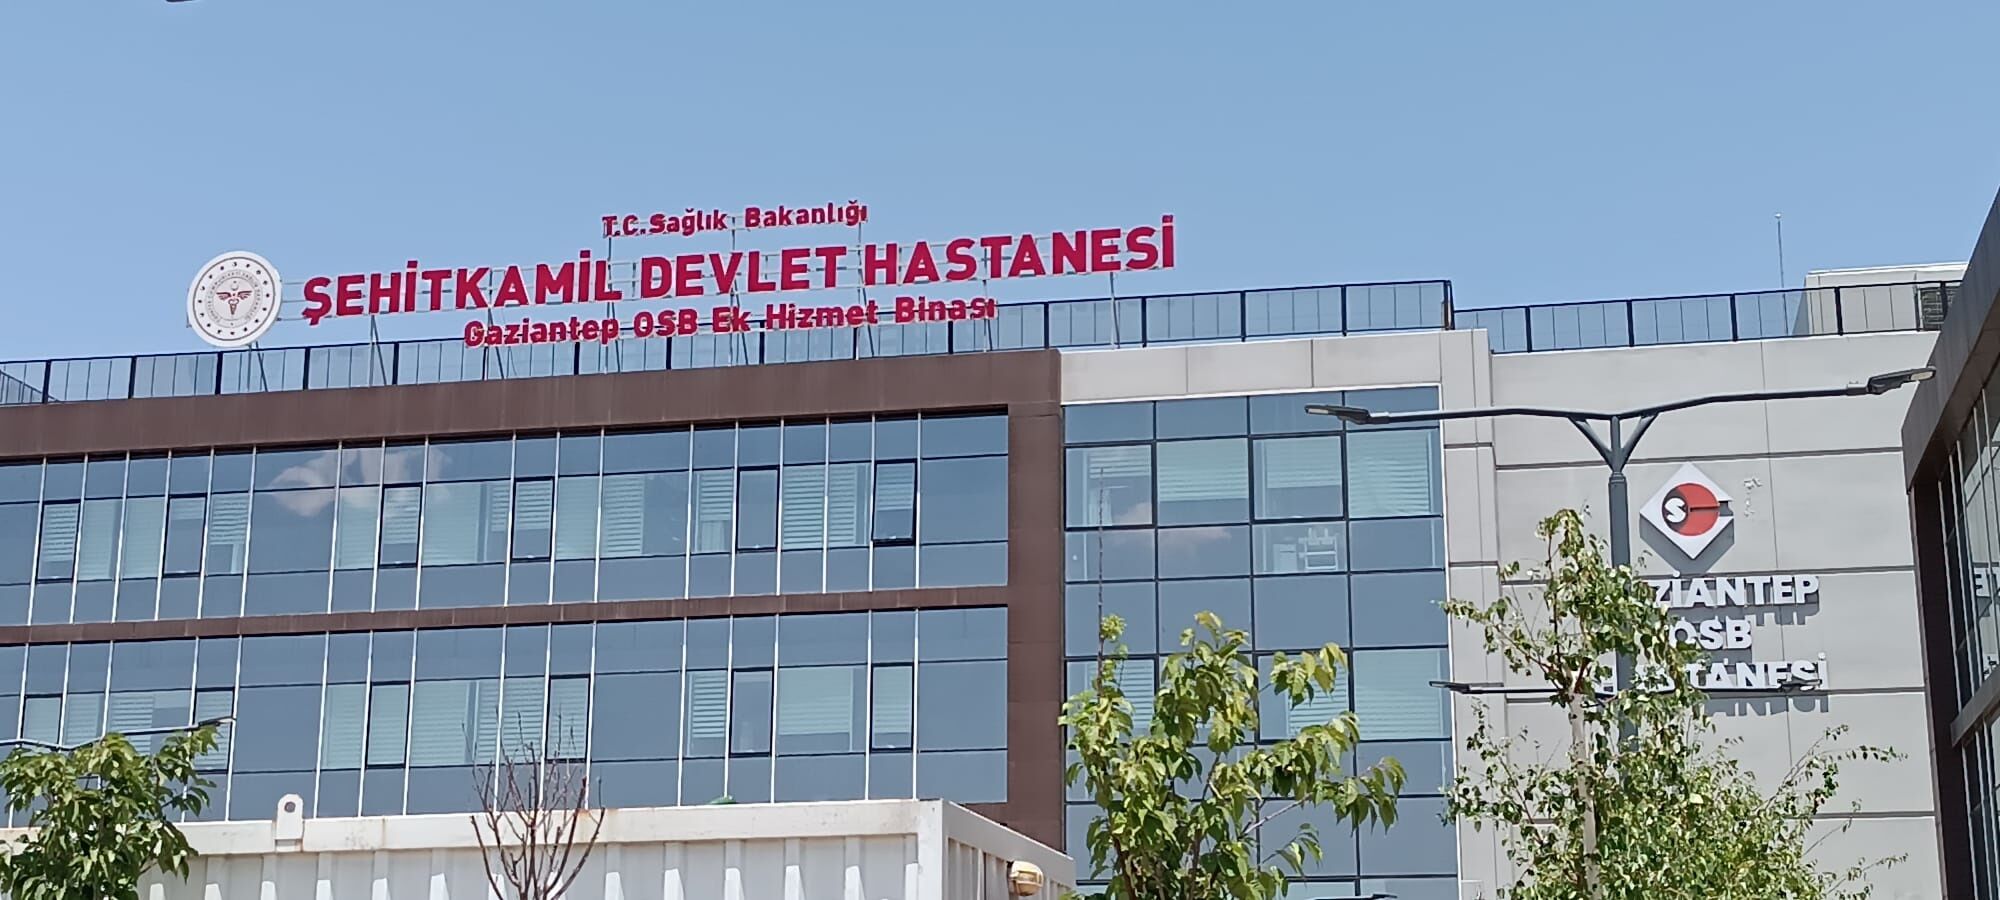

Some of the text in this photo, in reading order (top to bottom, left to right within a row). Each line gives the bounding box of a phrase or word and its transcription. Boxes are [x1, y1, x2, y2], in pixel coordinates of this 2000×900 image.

[745, 200, 868, 228] Bakanlığı
[303, 249, 623, 326] ŞEHİTKAMİL
[640, 245, 848, 299] DEVLET
[863, 214, 1175, 287] HASTANESİ
[464, 294, 998, 348] Gaziantep OSB Ek Hizmet Binası
[1645, 571, 1820, 608] ZİANTEP
[1668, 618, 1753, 650] OSB
